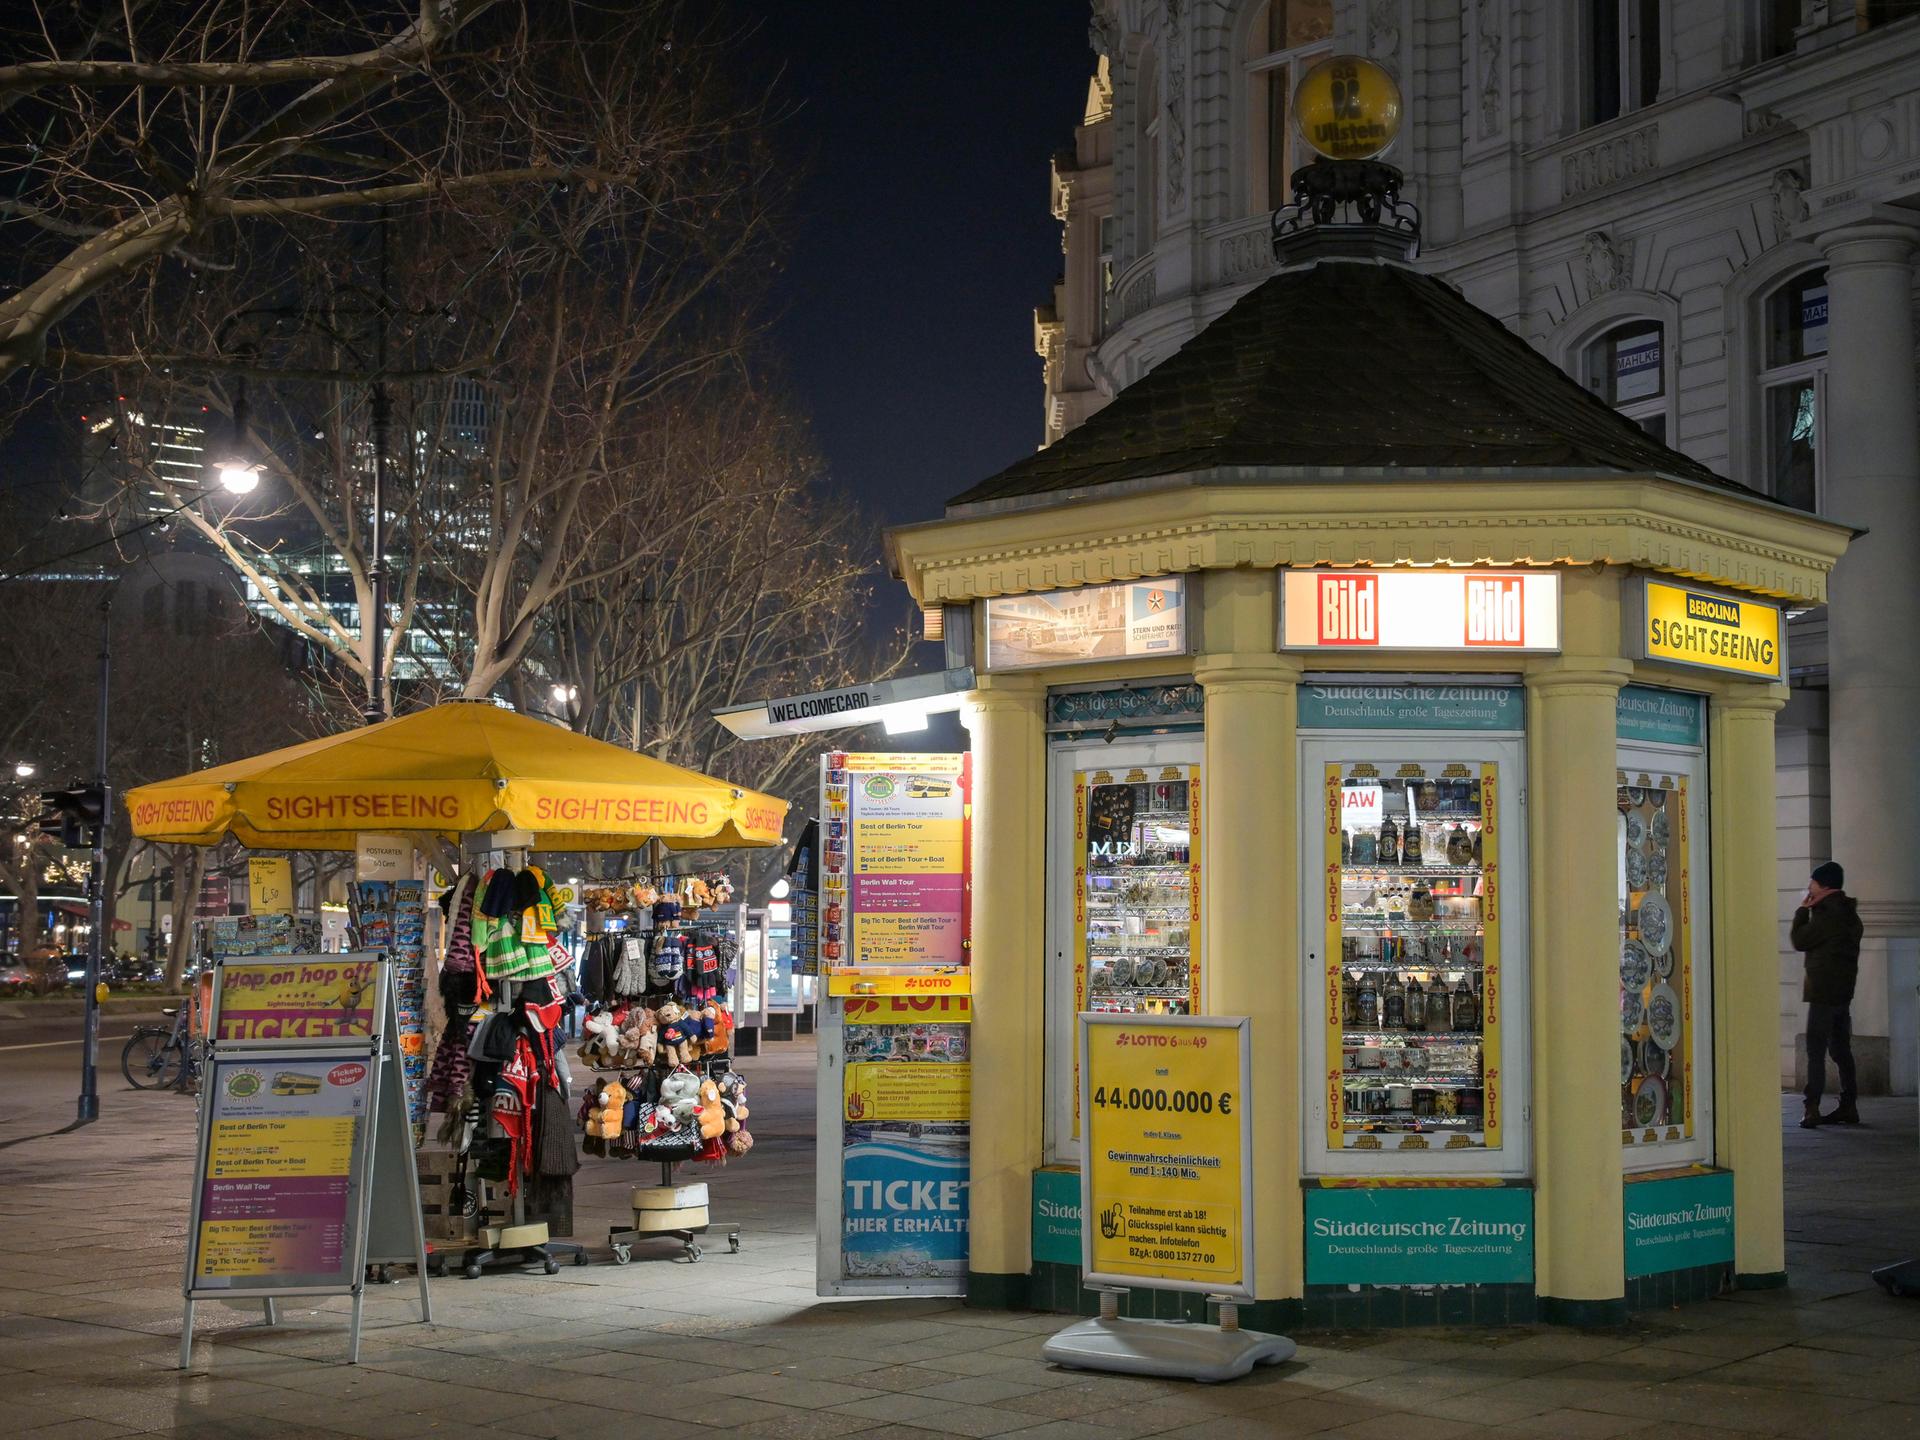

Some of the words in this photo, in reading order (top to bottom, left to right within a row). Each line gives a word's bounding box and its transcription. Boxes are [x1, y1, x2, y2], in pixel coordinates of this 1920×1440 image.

[1617, 350, 1659, 370] MAHLKE
[1322, 579, 1375, 641] Bild
[1468, 580, 1521, 642] Bild
[1688, 598, 1739, 623] BEROLINA
[1651, 617, 1773, 665] SIGHTSEEING
[773, 691, 870, 723] WELCOMECARD
[1324, 705, 1395, 717] Deutschlands
[1398, 706, 1428, 718] große
[1432, 706, 1498, 720] Tageszeitung
[1659, 697, 1696, 724] Zeitung
[136, 800, 215, 826] SIGHTSEEING
[267, 795, 459, 819] SIGHTSEEING
[536, 797, 708, 825] SIGHTSEEING
[366, 848, 402, 856] POSTKARTEN
[223, 970, 266, 991] Hop
[269, 971, 296, 985] on
[301, 967, 338, 986] hop
[342, 962, 374, 982] off
[919, 978, 952, 988] LOTTO
[267, 1001, 305, 1009] Sightseeing
[222, 1018, 369, 1040] TICKETS
[1131, 1034, 1167, 1047] LOTTO
[332, 1066, 363, 1078] Tickets
[339, 1075, 356, 1085] hier
[1094, 1087, 1213, 1114] 44.000.000
[1218, 1092, 1232, 1114] €
[1108, 1150, 1221, 1167] Gewinnwahrscheinlichkeit:
[1130, 1166, 1149, 1174] rund
[1181, 1168, 1199, 1178] Mio.
[1128, 1204, 1165, 1217] Teilnahme
[1167, 1209, 1182, 1218] erst
[1183, 1210, 1193, 1218] ab
[1194, 1210, 1206, 1219] 18!
[1628, 1210, 1694, 1230] Süddeutsche
[1694, 1203, 1732, 1223] Zeitung
[846, 1218, 888, 1232] HIER
[1128, 1219, 1173, 1232] Glücksspiel
[1175, 1224, 1195, 1233] kann
[1197, 1225, 1227, 1237] süchtig
[1313, 1218, 1446, 1237] Süddeutsche
[1448, 1217, 1526, 1241] Zeitung
[1128, 1234, 1158, 1244] machen.
[1160, 1236, 1200, 1248] Infotelefon
[1328, 1244, 1402, 1254] Deutschlands
[1407, 1244, 1438, 1255] große
[1443, 1243, 1513, 1255] Tageszeitung
[1129, 1247, 1151, 1259] BZgA:
[1153, 1249, 1175, 1260] 0800
[1176, 1251, 1191, 1261] 137
[1193, 1252, 1202, 1262] 27
[1203, 1253, 1215, 1263] 00
